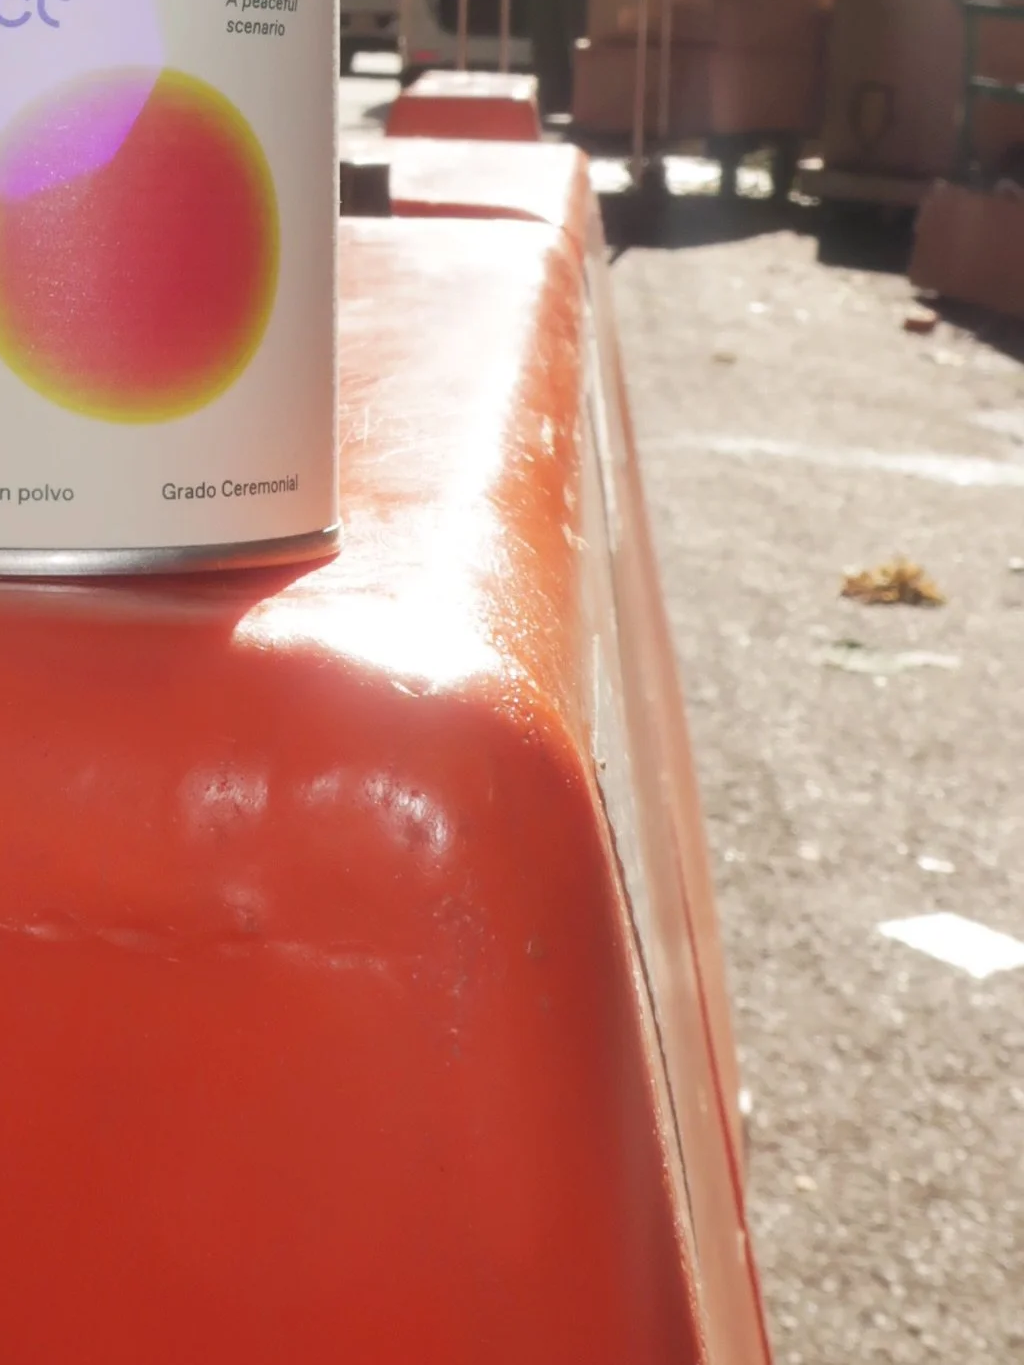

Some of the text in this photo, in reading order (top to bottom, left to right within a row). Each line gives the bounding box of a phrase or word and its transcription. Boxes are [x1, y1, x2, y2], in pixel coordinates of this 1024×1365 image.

[226, 19, 285, 36] scenario
[18, 484, 74, 505] polvo
[162, 473, 298, 500] Grado Ceremonial
